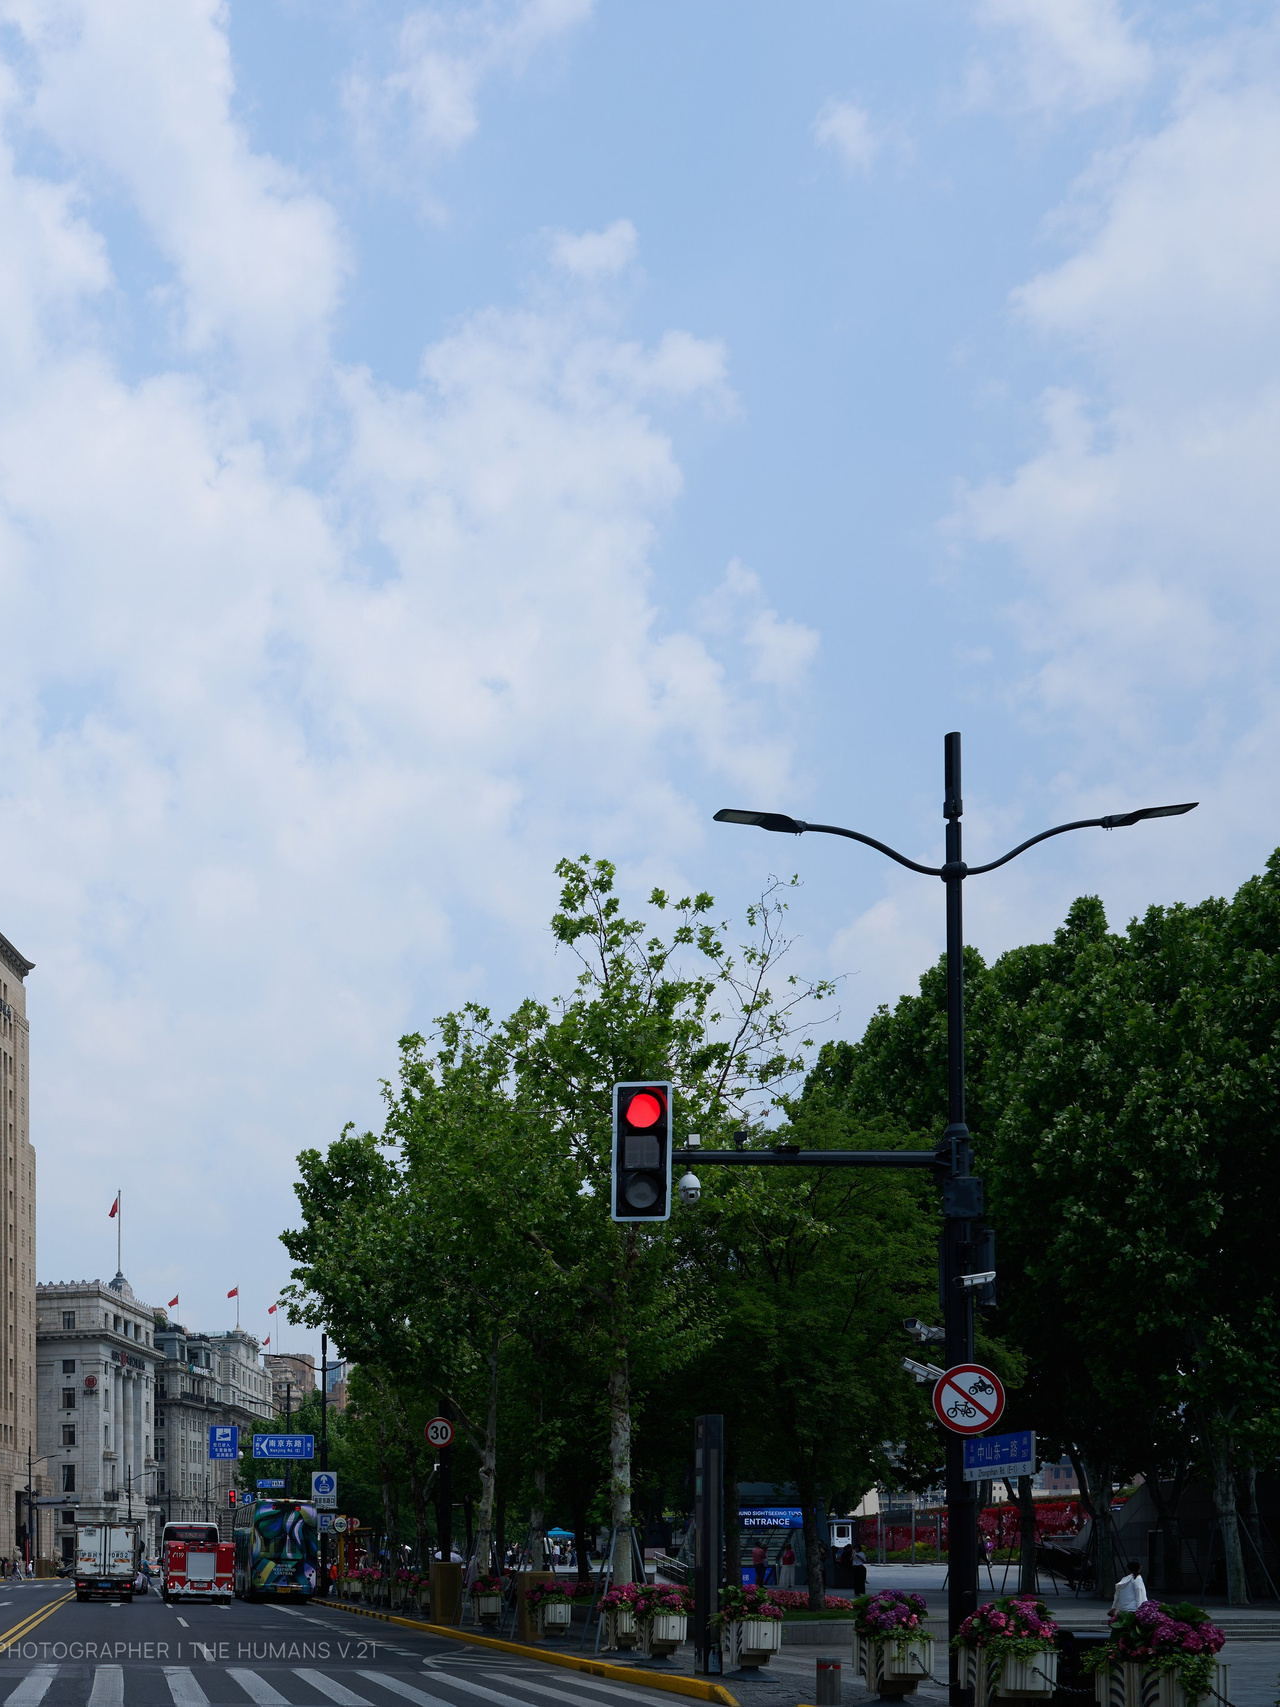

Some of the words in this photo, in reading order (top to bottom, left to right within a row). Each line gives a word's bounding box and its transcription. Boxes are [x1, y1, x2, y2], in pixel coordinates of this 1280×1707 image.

[431, 1425, 449, 1440] 30
[269, 1440, 302, 1448] 南京东路
[977, 1440, 1018, 1462] 中山东一路
[978, 1468, 999, 1478] Zhongshan
[1022, 1464, 1027, 1473] S
[744, 1518, 790, 1526] ENTRANCE
